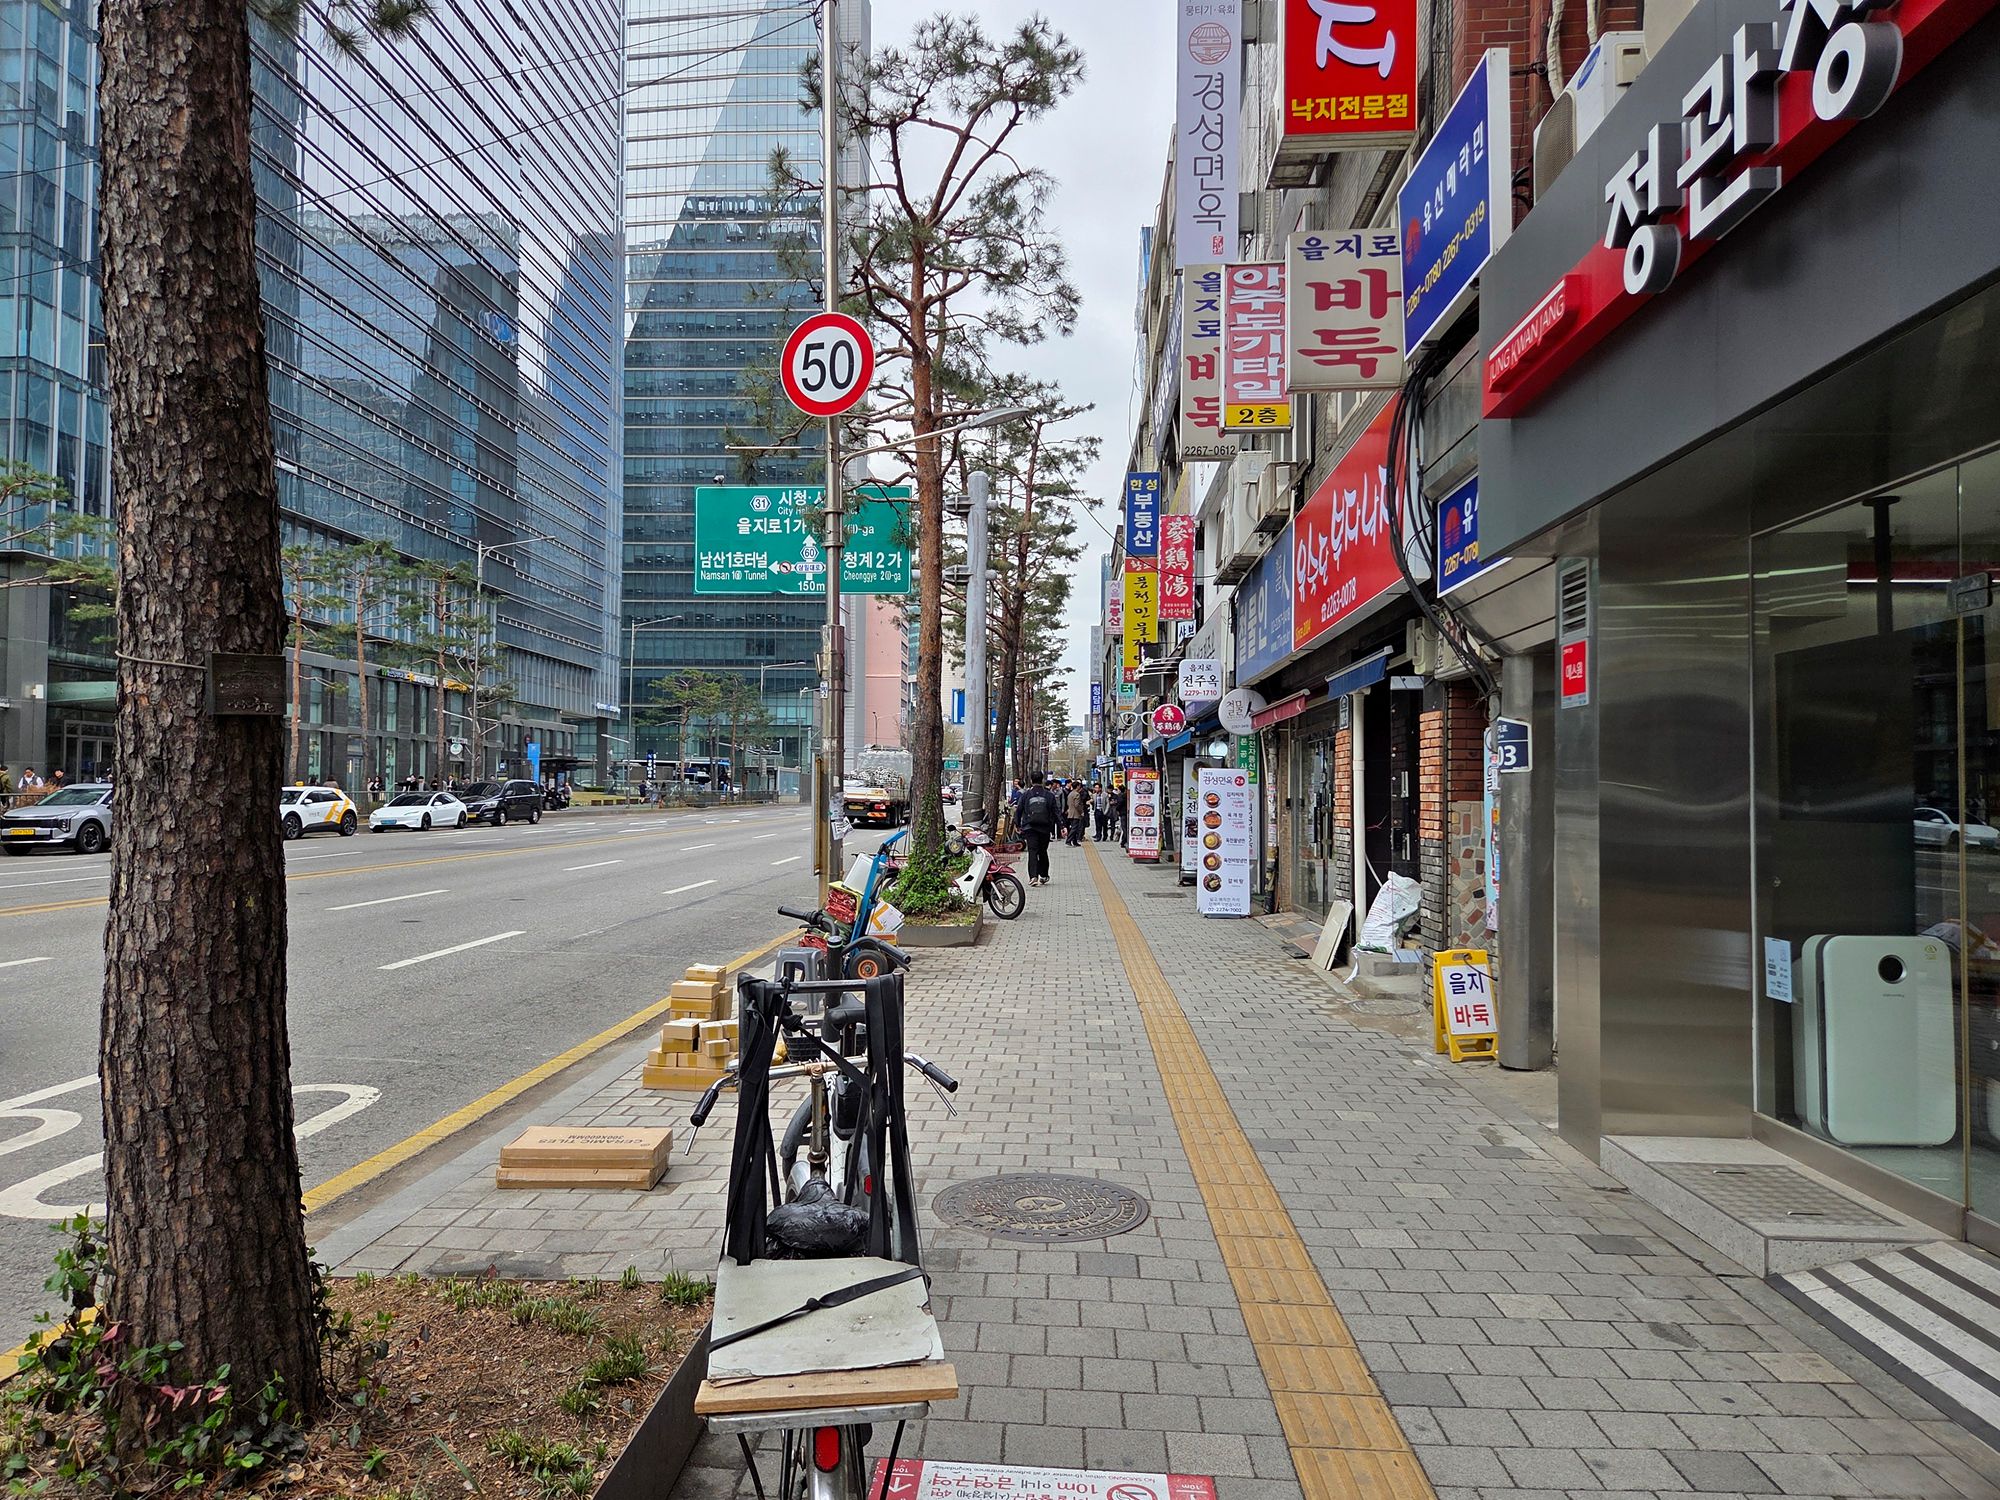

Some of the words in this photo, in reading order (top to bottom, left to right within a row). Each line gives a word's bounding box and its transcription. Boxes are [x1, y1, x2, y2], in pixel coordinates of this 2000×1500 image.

[1291, 93, 1408, 121] 낙지전문점
[1188, 71, 1227, 233] 경성면옥
[1297, 234, 1401, 261] 을지로
[1297, 268, 1402, 379] 바둑
[802, 340, 855, 391] 50
[1238, 408, 1279, 424] 2층
[1184, 445, 1236, 456] 2267-0612
[1131, 480, 1158, 491] 한성
[755, 498, 766, 510] 31
[1133, 493, 1154, 547] 부동산
[700, 551, 768, 569] 남산1호터널
[804, 548, 816, 558] 60
[700, 570, 730, 581] Namsan
[744, 570, 768, 581] Tunnel
[843, 570, 877, 583] Cheonggye
[798, 580, 826, 592] 150m
[1109, 599, 1121, 627] 부동산
[1189, 663, 1213, 672] 을지로
[1182, 673, 1220, 688] 전주옥
[1184, 689, 1218, 697] 2279-1710
[1449, 972, 1485, 995] 을지
[1454, 1003, 1490, 1028] 바둑
[930, 1472, 1016, 1491] 금연구역
[1020, 1479, 1052, 1490] 이내
[1057, 1481, 1098, 1495] 10m
